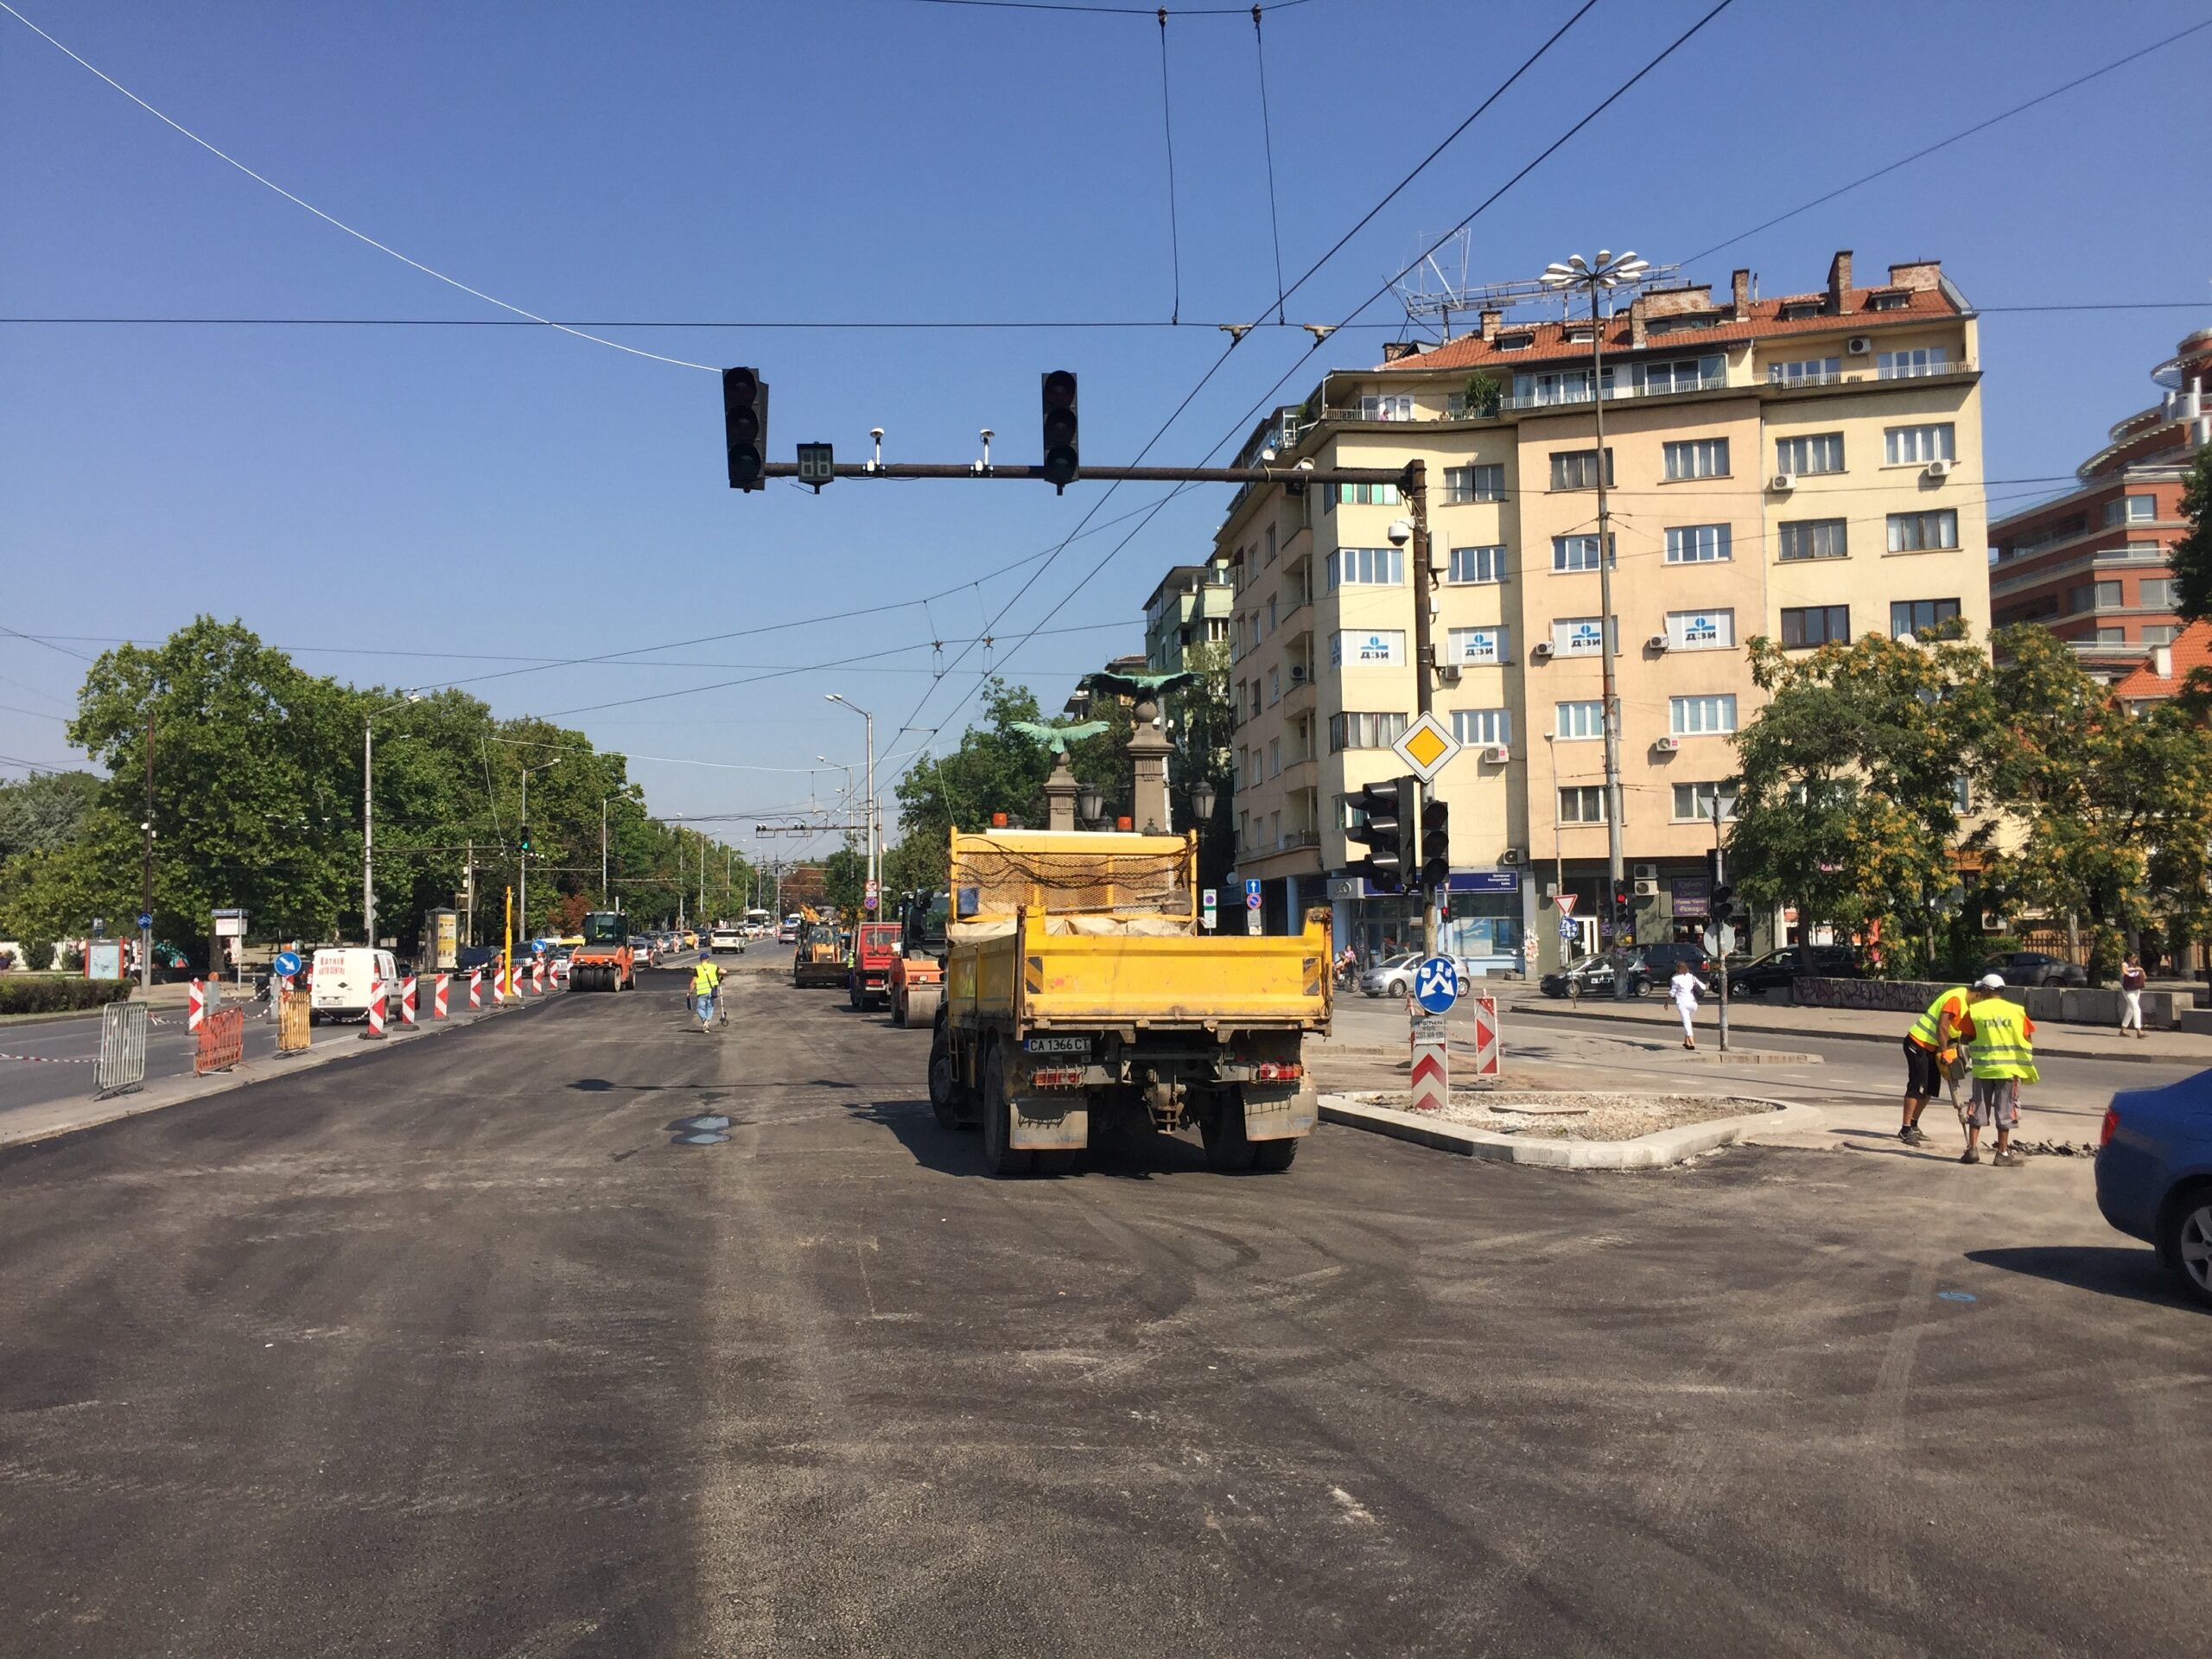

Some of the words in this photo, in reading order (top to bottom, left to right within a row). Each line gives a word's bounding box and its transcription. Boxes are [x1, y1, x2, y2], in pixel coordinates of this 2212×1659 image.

[1685, 632, 1716, 641] ДЗИ
[1571, 639, 1601, 648] ДЗИ
[1465, 648, 1493, 657] ДЗИ
[1031, 1039, 1045, 1052] CA
[1048, 1039, 1073, 1051] 1366
[1075, 1039, 1089, 1050] CT
